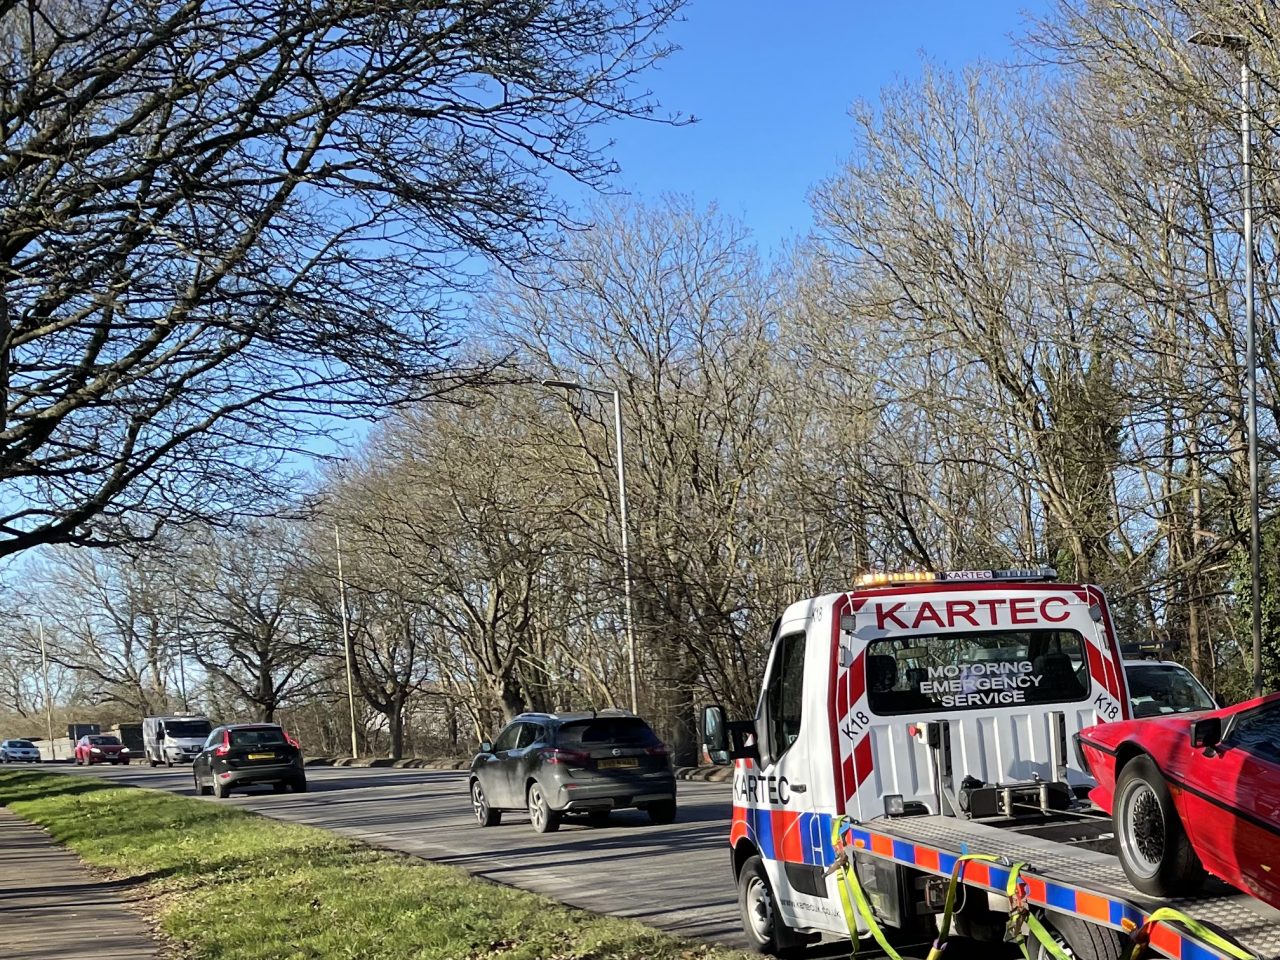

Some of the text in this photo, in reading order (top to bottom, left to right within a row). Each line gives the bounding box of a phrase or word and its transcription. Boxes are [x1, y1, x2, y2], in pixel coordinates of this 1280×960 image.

[945, 571, 992, 579] KARTEC
[875, 596, 1071, 630] KARTEC
[927, 661, 1033, 679] MOTORING
[919, 674, 1044, 694] EMERGENCY
[941, 689, 1026, 707] SERVICE
[1093, 693, 1119, 719] K18
[841, 711, 870, 741] K18
[734, 774, 791, 805] KARTEC
